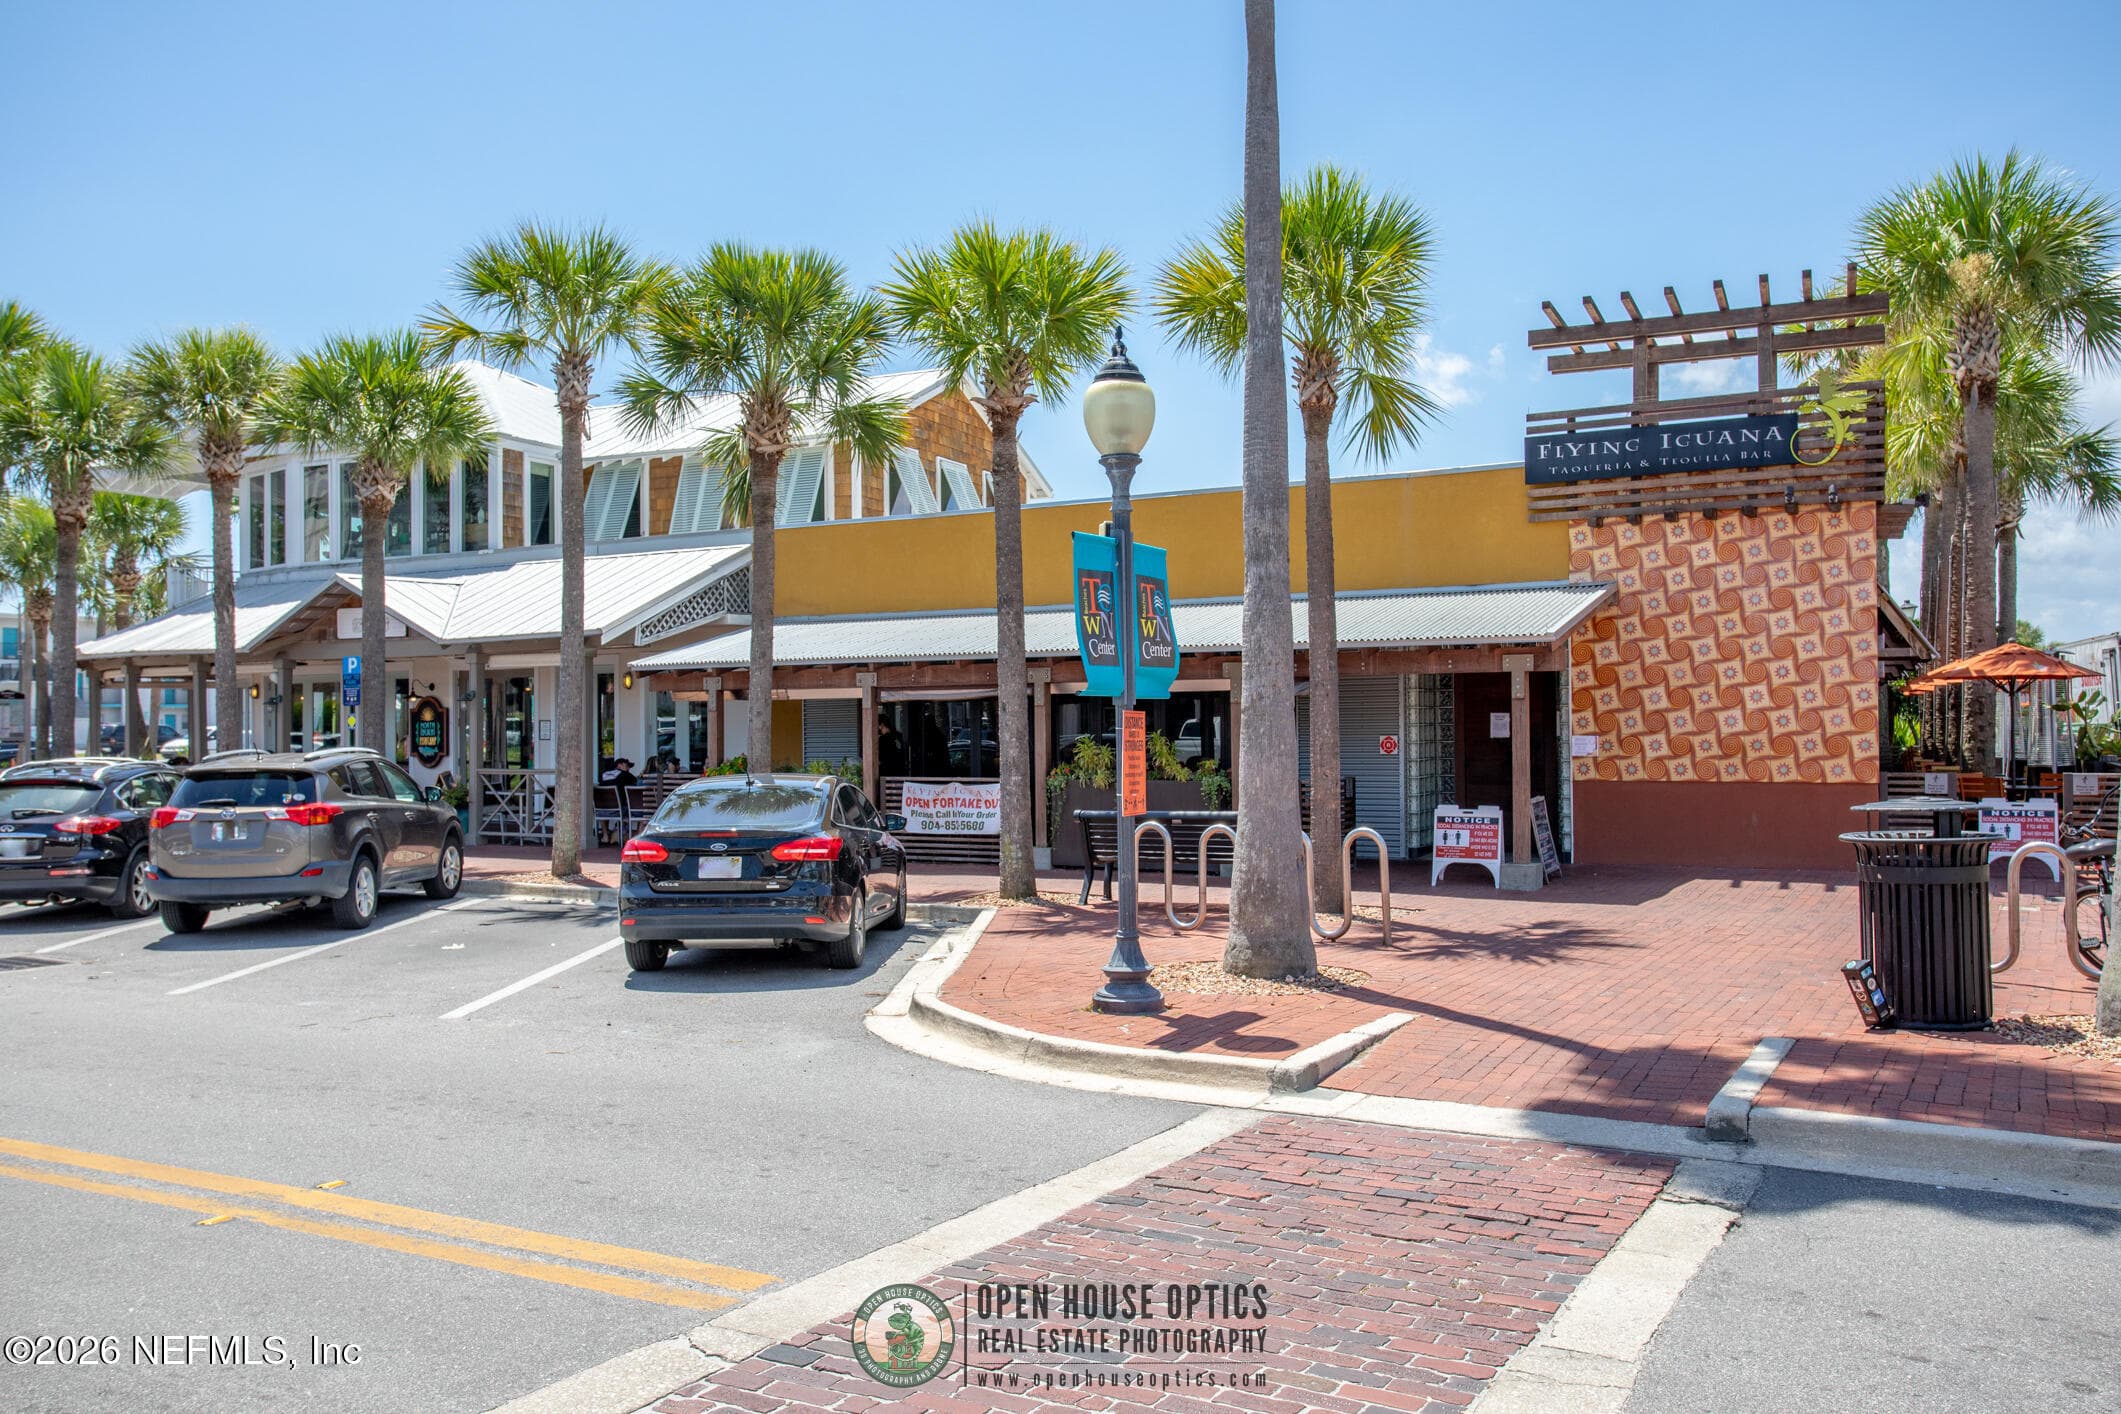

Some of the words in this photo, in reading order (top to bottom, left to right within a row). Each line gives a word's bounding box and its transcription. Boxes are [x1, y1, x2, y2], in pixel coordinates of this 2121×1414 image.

[1537, 438, 1641, 460] FLYING
[1659, 426, 1785, 449] IGUANA
[1548, 461, 1632, 475] TAQUERIA
[1639, 459, 1651, 468] &
[1659, 453, 1731, 466] TEQUILA
[1740, 450, 1772, 459] BAR
[1089, 639, 1115, 657] Center
[1142, 641, 1172, 659] Center
[348, 657, 358, 673] P
[905, 796, 930, 809] OPEN
[933, 797, 955, 809] FOR
[955, 797, 982, 809] TAKE
[984, 798, 1000, 809] OU
[911, 809, 934, 819] Please
[936, 810, 951, 819] Call
[957, 810, 974, 819] Your
[976, 811, 998, 819] Order
